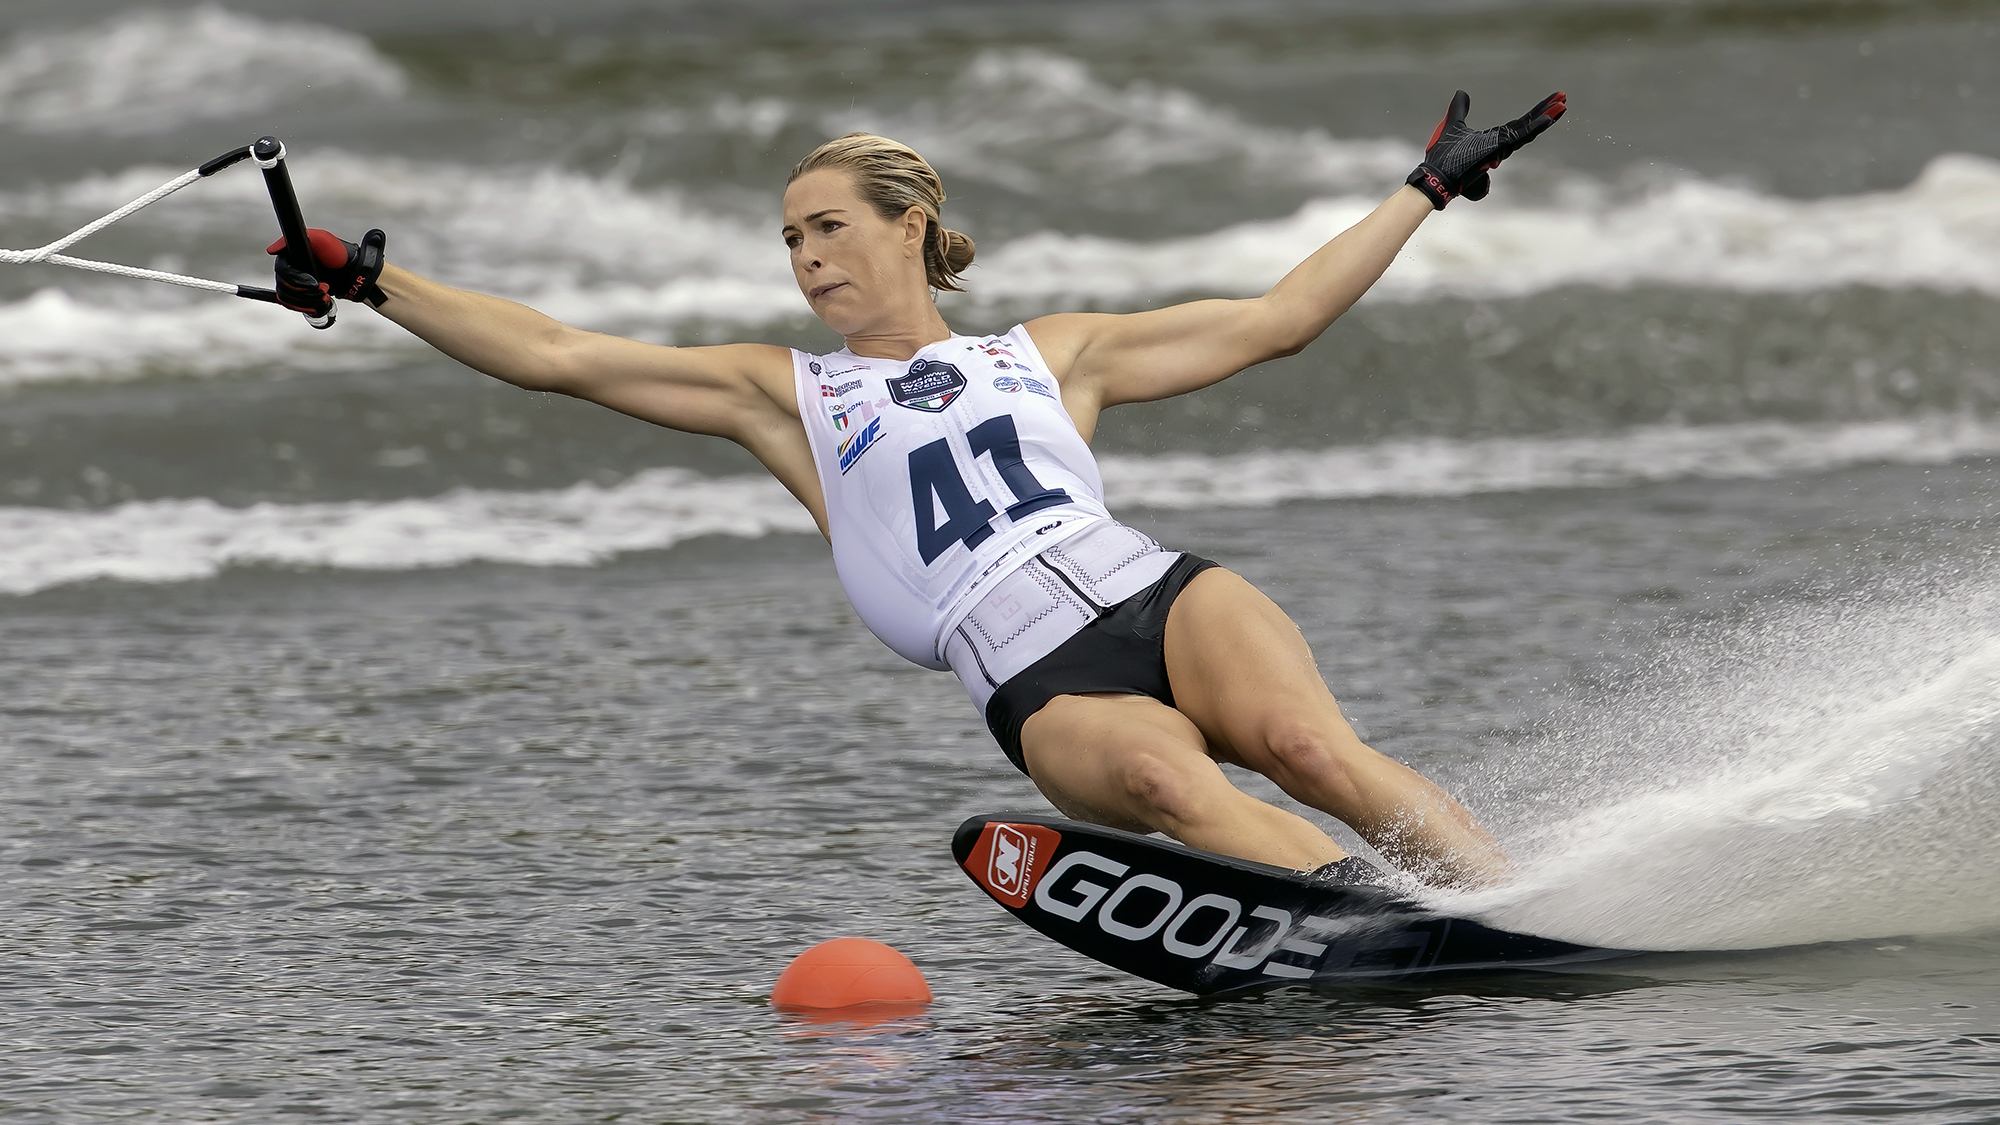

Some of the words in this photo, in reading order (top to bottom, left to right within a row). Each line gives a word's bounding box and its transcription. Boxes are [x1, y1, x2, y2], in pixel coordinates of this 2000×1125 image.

[834, 379, 862, 393] REGIONE
[901, 374, 951, 389] WORLD
[903, 378, 952, 392] WATERSKI
[847, 401, 864, 414] CONI
[908, 414, 1074, 567] 41
[1020, 835, 1038, 900] NAUTIQUE
[1034, 851, 1349, 979] GOODE
